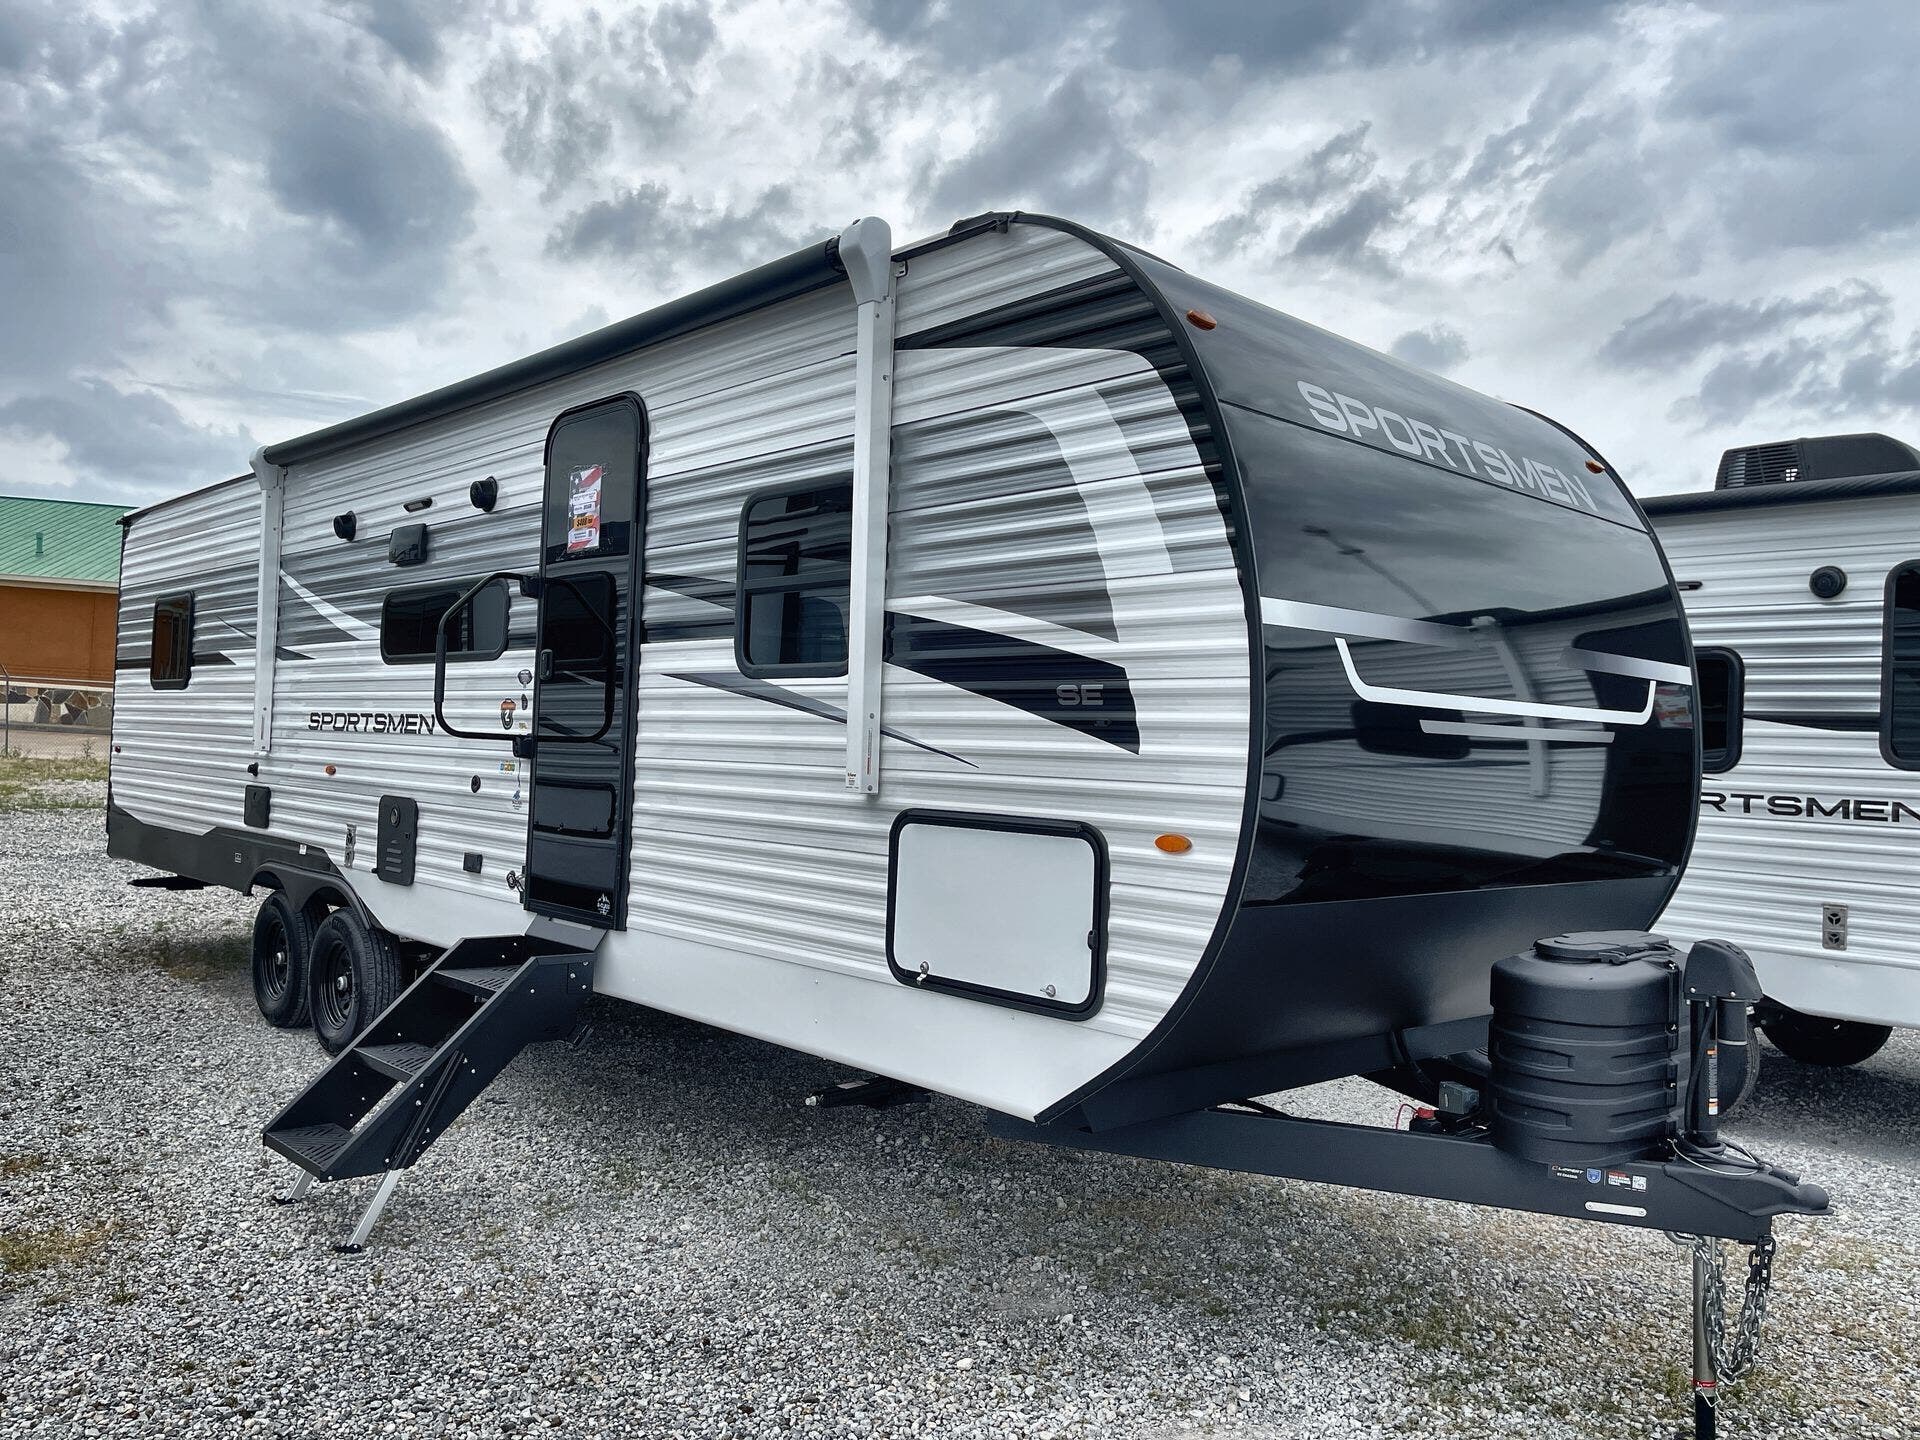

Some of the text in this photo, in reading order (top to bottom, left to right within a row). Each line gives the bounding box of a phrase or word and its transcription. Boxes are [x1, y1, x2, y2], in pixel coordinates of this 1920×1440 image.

[1297, 380, 1598, 511] SPORTSMEN
[1056, 684, 1104, 706] SE
[308, 712, 435, 734] SPORTSMEN
